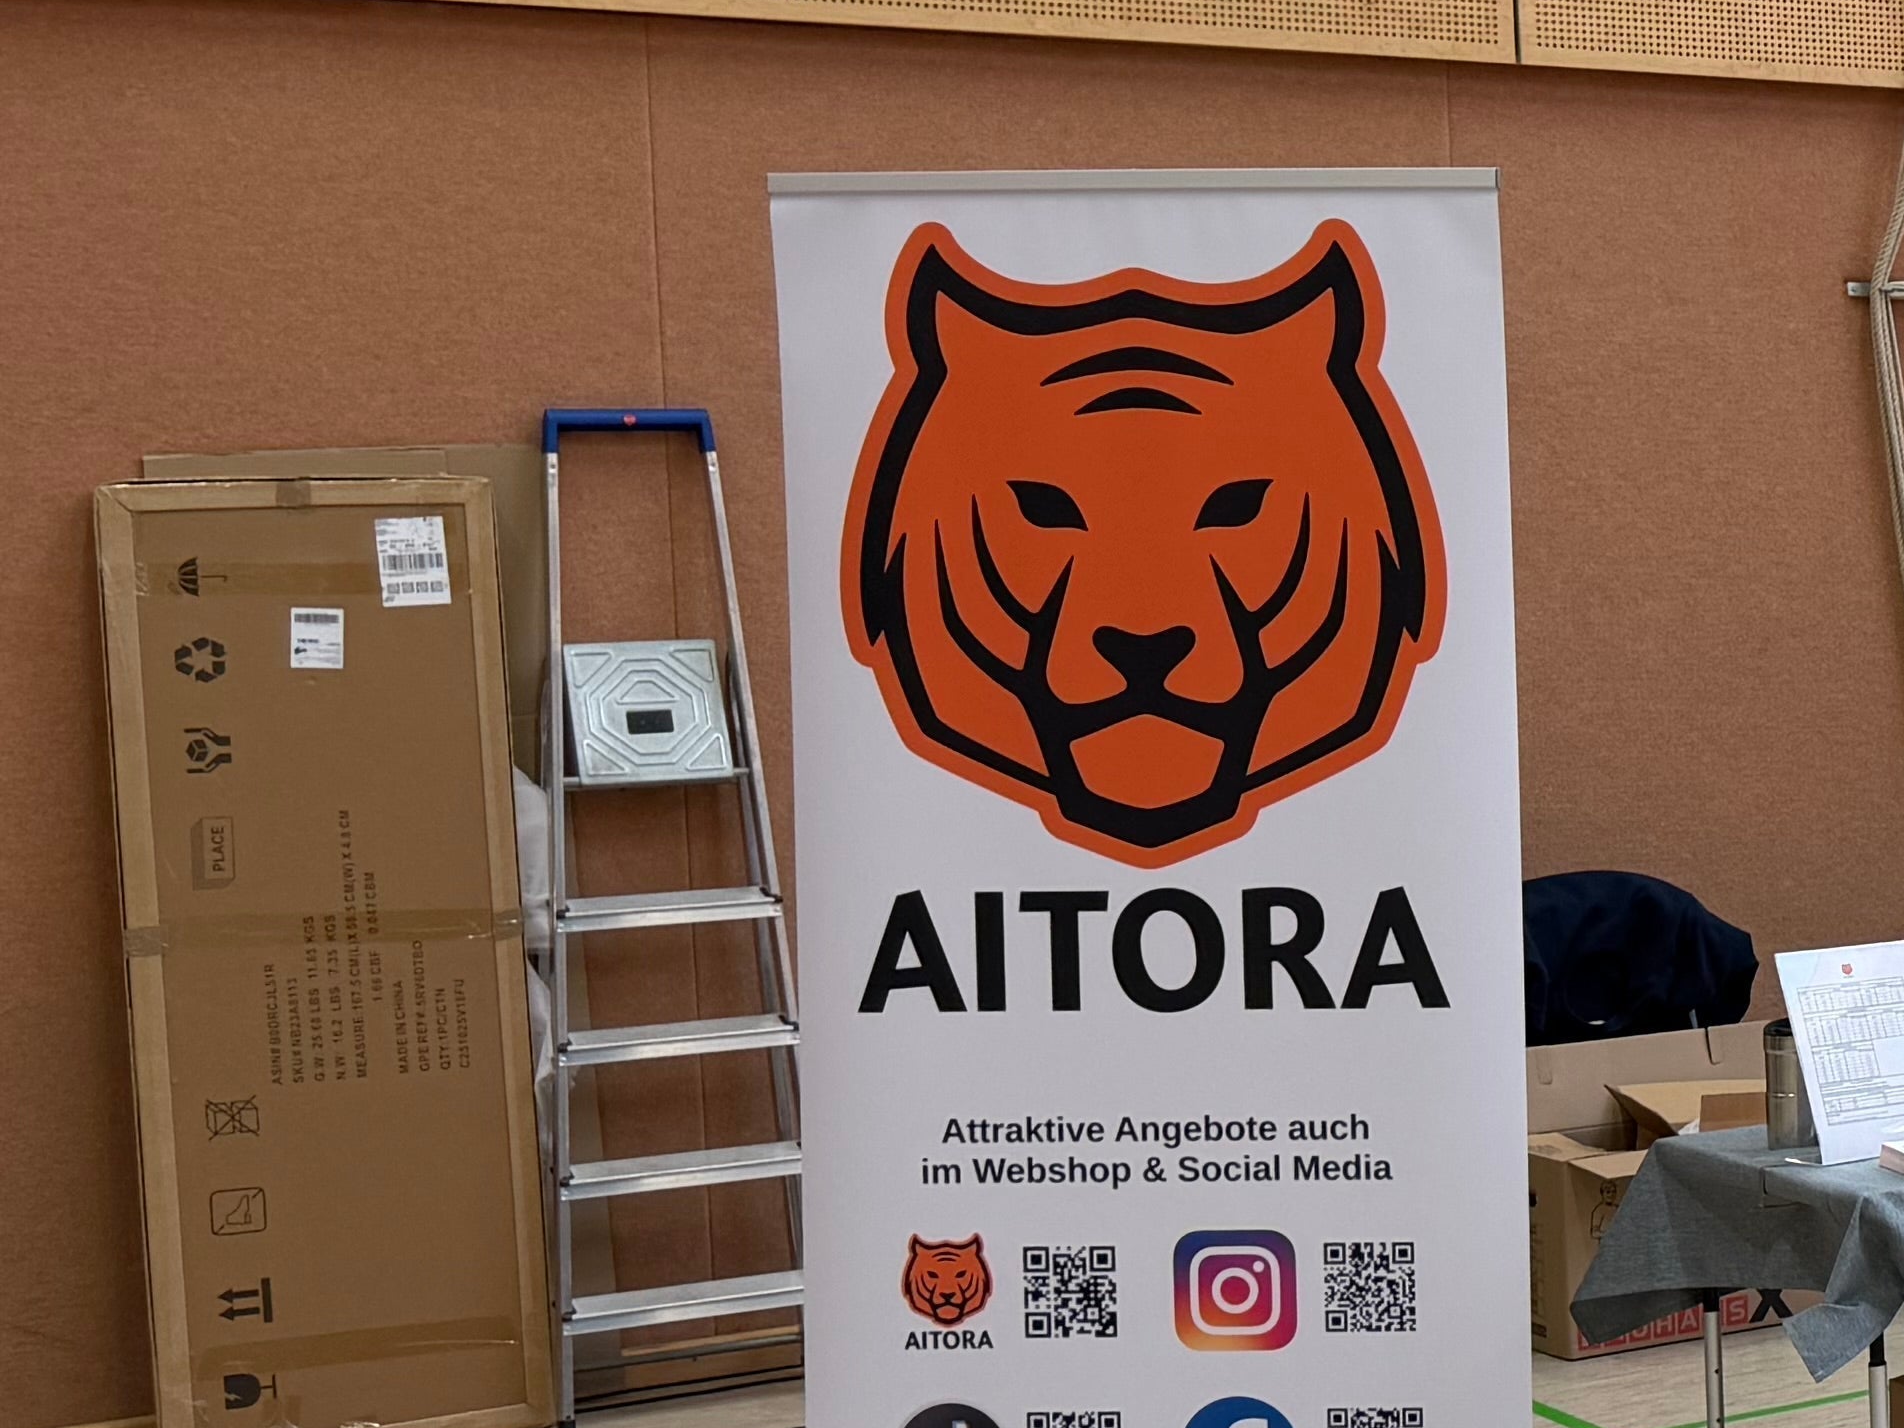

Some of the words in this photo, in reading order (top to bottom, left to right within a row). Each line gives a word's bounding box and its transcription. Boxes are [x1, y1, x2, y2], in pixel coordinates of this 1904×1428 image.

[338, 810, 350, 829] CM
[210, 826, 225, 872] PLACE
[364, 872, 376, 900] CBM
[303, 916, 316, 943] KGS
[324, 915, 337, 942] KGS
[857, 885, 1451, 1014] AITORA
[308, 988, 321, 1013] LBS
[329, 986, 342, 1012] LBS
[392, 980, 406, 1021] CHINA
[394, 1022, 407, 1036] IN
[396, 1037, 409, 1075] MADE
[941, 1115, 1105, 1144] Attraktive
[1114, 1114, 1277, 1149] Angebote
[1288, 1113, 1369, 1141] auch
[921, 1157, 962, 1185] im
[971, 1156, 1131, 1190] Webshop
[1142, 1156, 1167, 1183] &
[1178, 1154, 1281, 1183] Social
[1293, 1153, 1394, 1181] Media
[904, 1329, 994, 1351] AITORA
